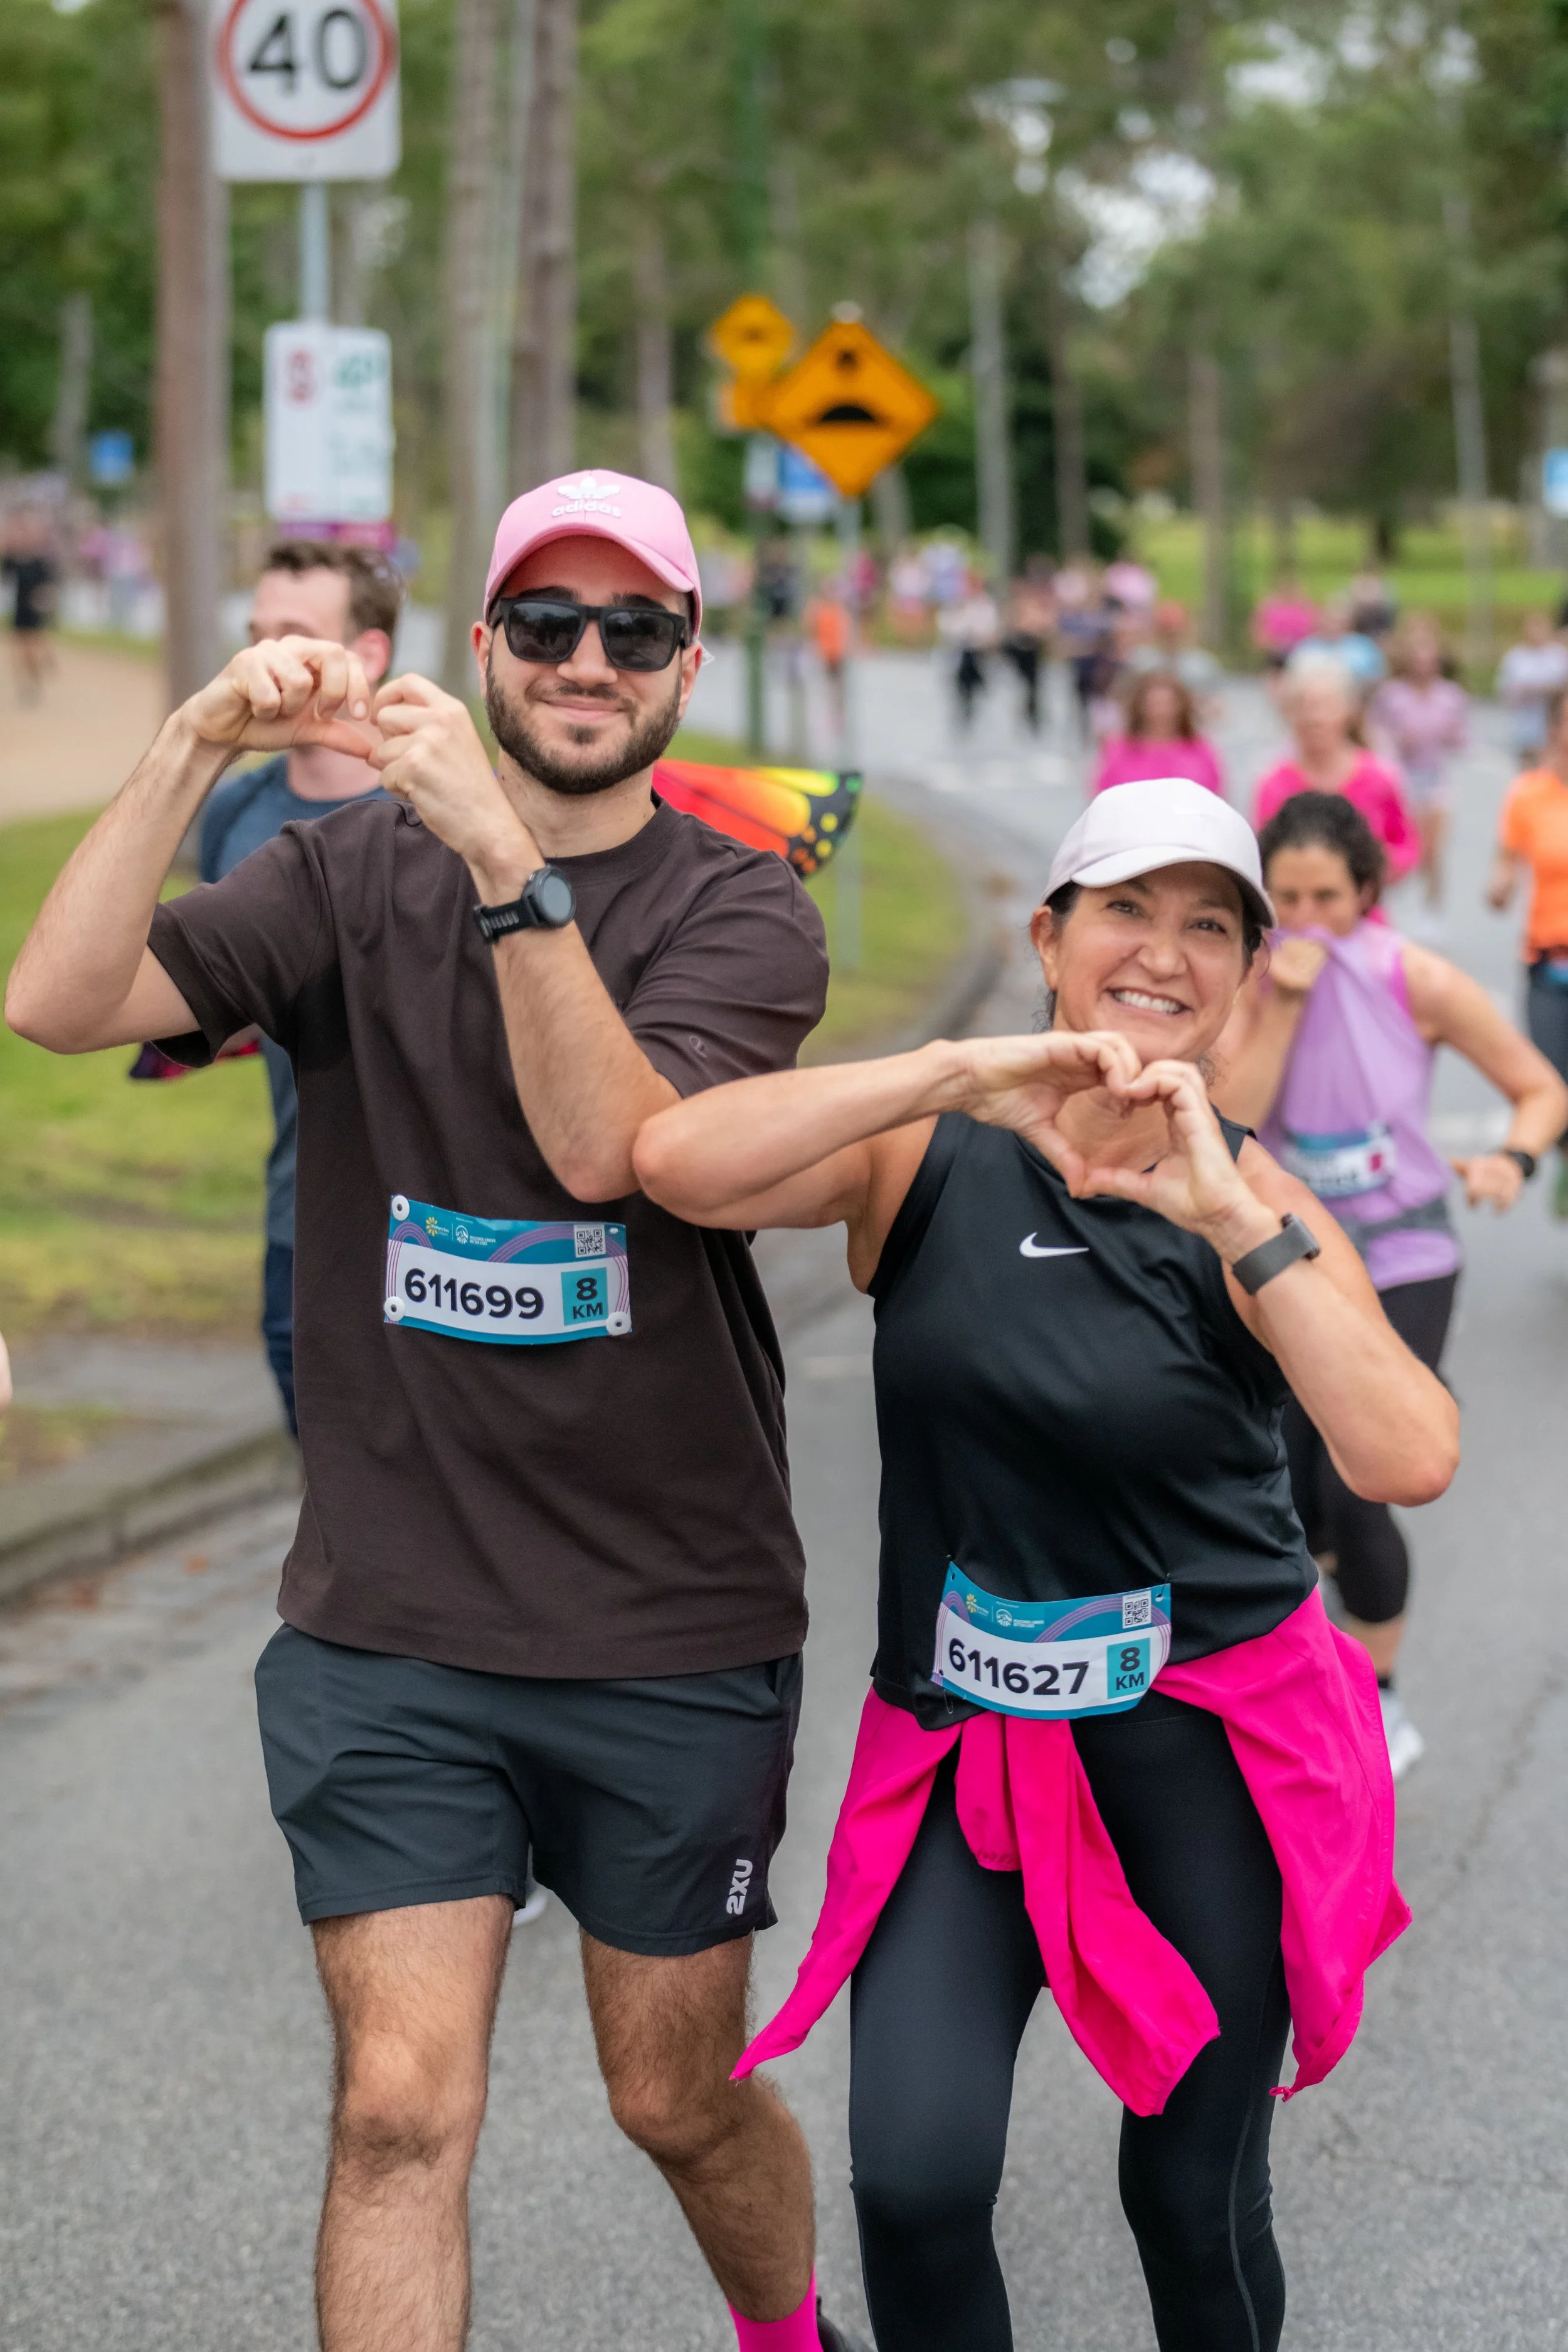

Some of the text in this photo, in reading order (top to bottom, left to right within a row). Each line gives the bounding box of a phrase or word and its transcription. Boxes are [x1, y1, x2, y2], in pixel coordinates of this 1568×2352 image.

[248, 8, 368, 95] 40
[552, 499, 622, 519] adidas
[405, 1268, 544, 1319] 611699
[576, 1277, 598, 1301] 8
[572, 1302, 604, 1320] KM
[949, 1638, 1089, 1695] 611627
[1120, 1647, 1140, 1671] 8
[1116, 1671, 1145, 1691] KM
[726, 1858, 753, 1915] 2XU
